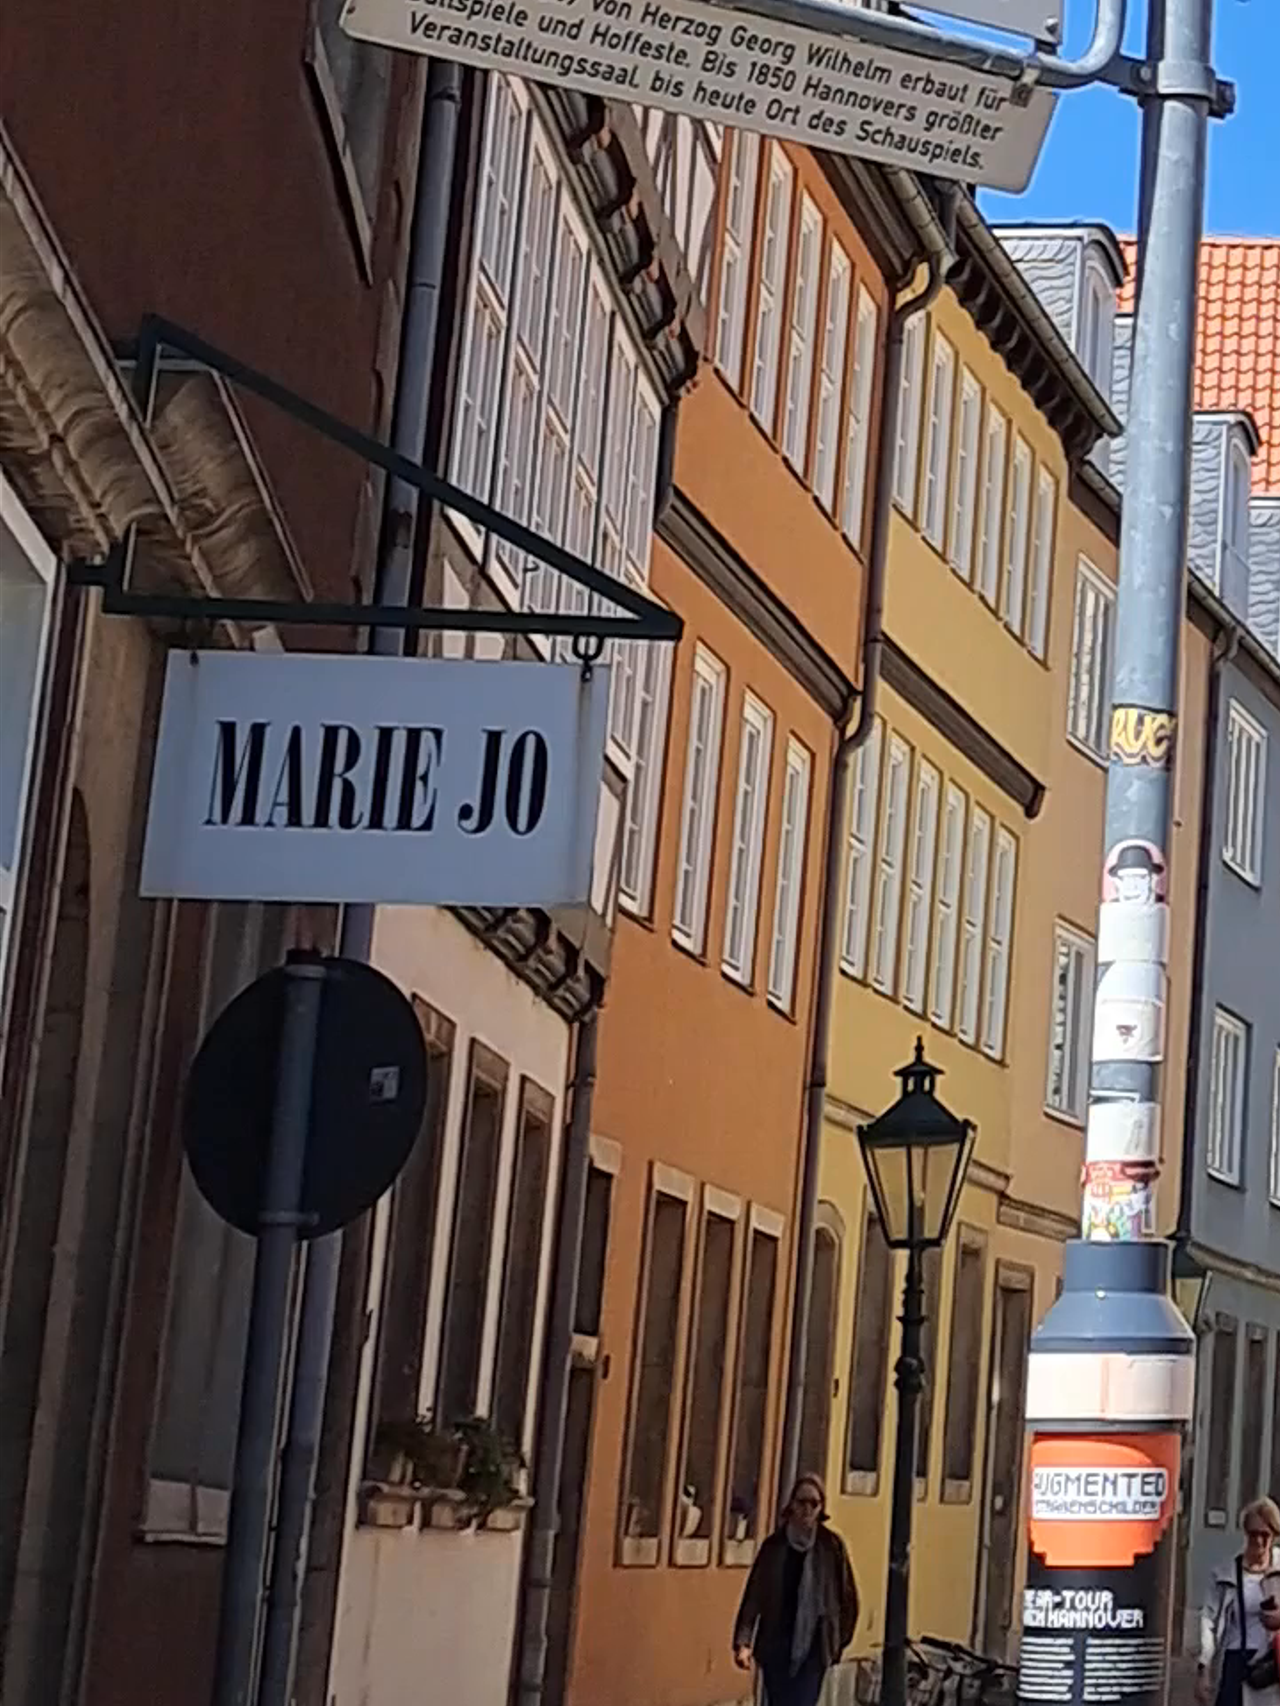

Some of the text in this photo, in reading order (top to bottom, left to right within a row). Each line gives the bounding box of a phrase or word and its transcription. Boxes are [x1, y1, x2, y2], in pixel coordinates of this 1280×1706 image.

[538, 14, 585, 41] und
[590, 23, 692, 69] Hoffeste.
[701, 50, 736, 79] Bis
[746, 59, 797, 92] 1850
[802, 76, 917, 122] Hannovers
[924, 106, 1004, 142] größter
[640, 2, 721, 46] Herzog
[729, 25, 796, 65] Georg
[806, 43, 892, 84] Wilhelm
[900, 72, 970, 104] erbaut
[974, 86, 1008, 112] für
[649, 70, 684, 98] bis
[692, 80, 757, 115] heute
[765, 98, 801, 126] Ort
[807, 109, 848, 137] des
[854, 120, 985, 170] Schauspiels.
[202, 720, 548, 836] MARIE JO
